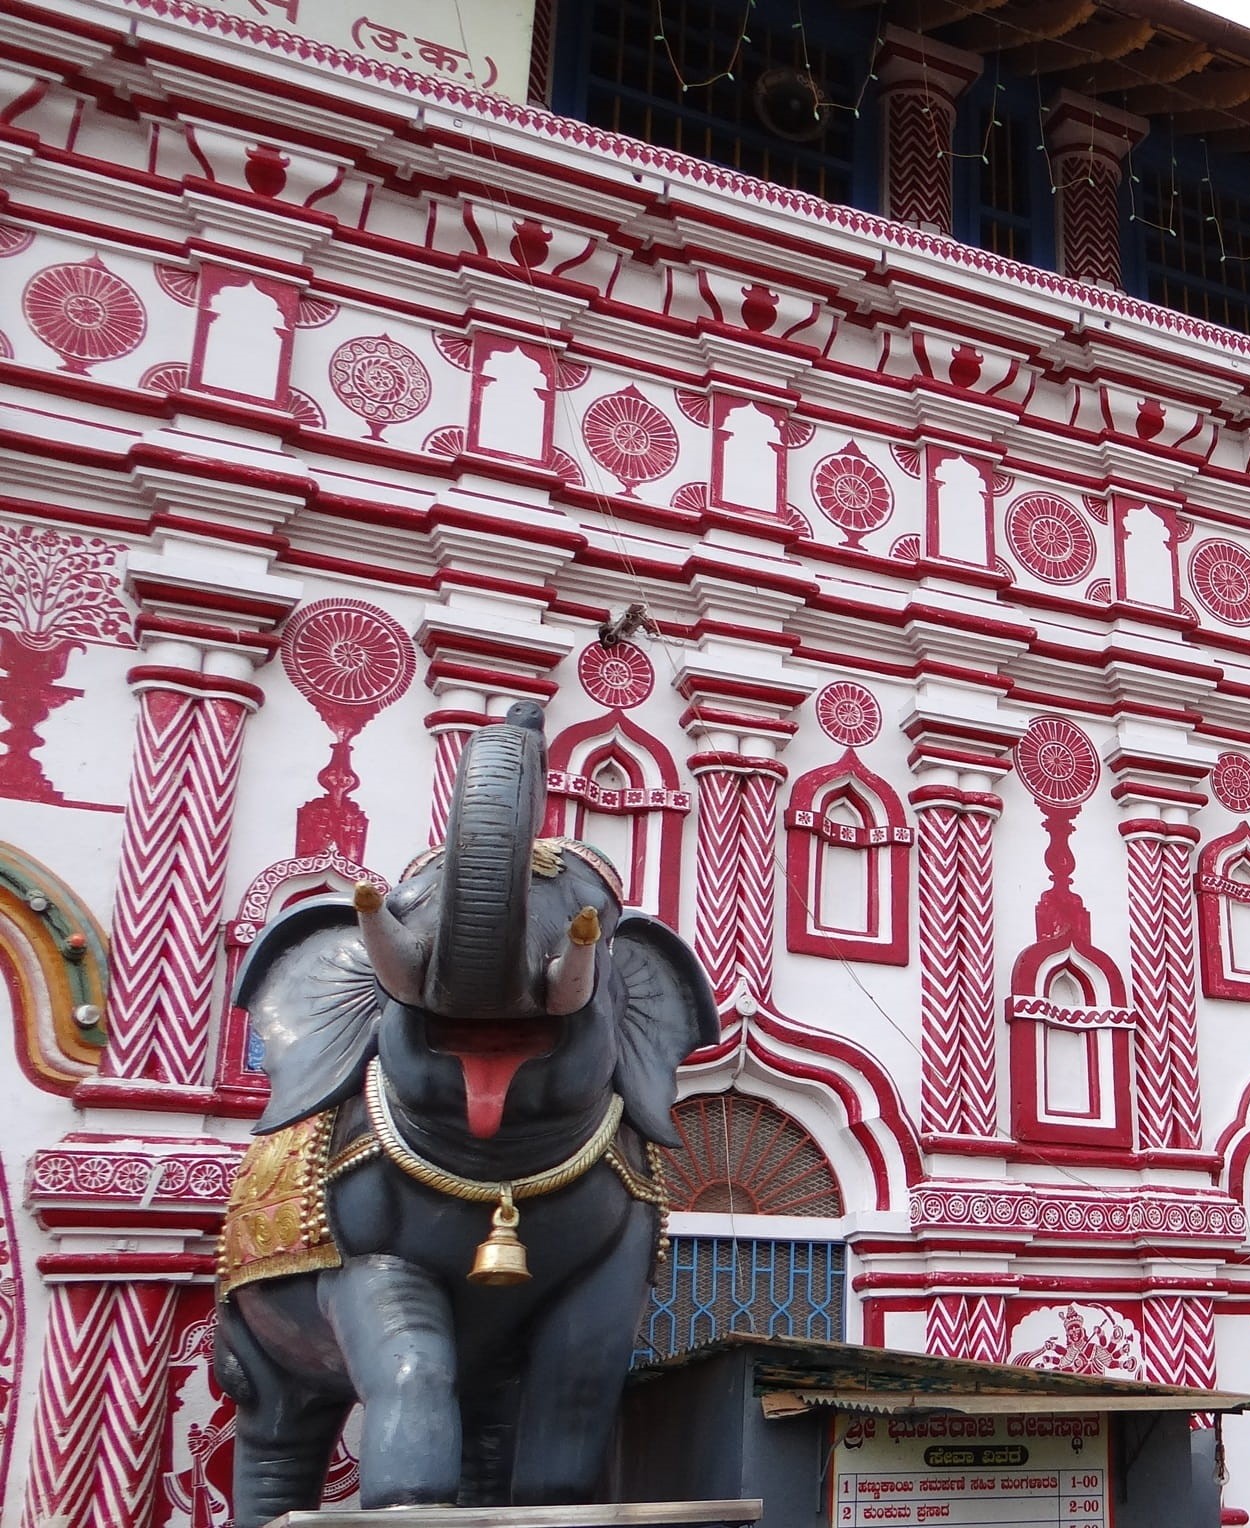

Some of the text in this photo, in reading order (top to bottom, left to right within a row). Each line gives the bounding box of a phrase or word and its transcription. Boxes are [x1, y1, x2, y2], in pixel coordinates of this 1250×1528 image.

[929, 1447, 974, 1465] ಸೇವಾ
[843, 1480, 850, 1494] 1
[970, 1476, 996, 1491] ಸಹಿತ
[1071, 1475, 1098, 1489] 1-00
[842, 1499, 1099, 1522] 2 ಕುಂಕುಮ ಪ್ರಸಾದ 2-00
